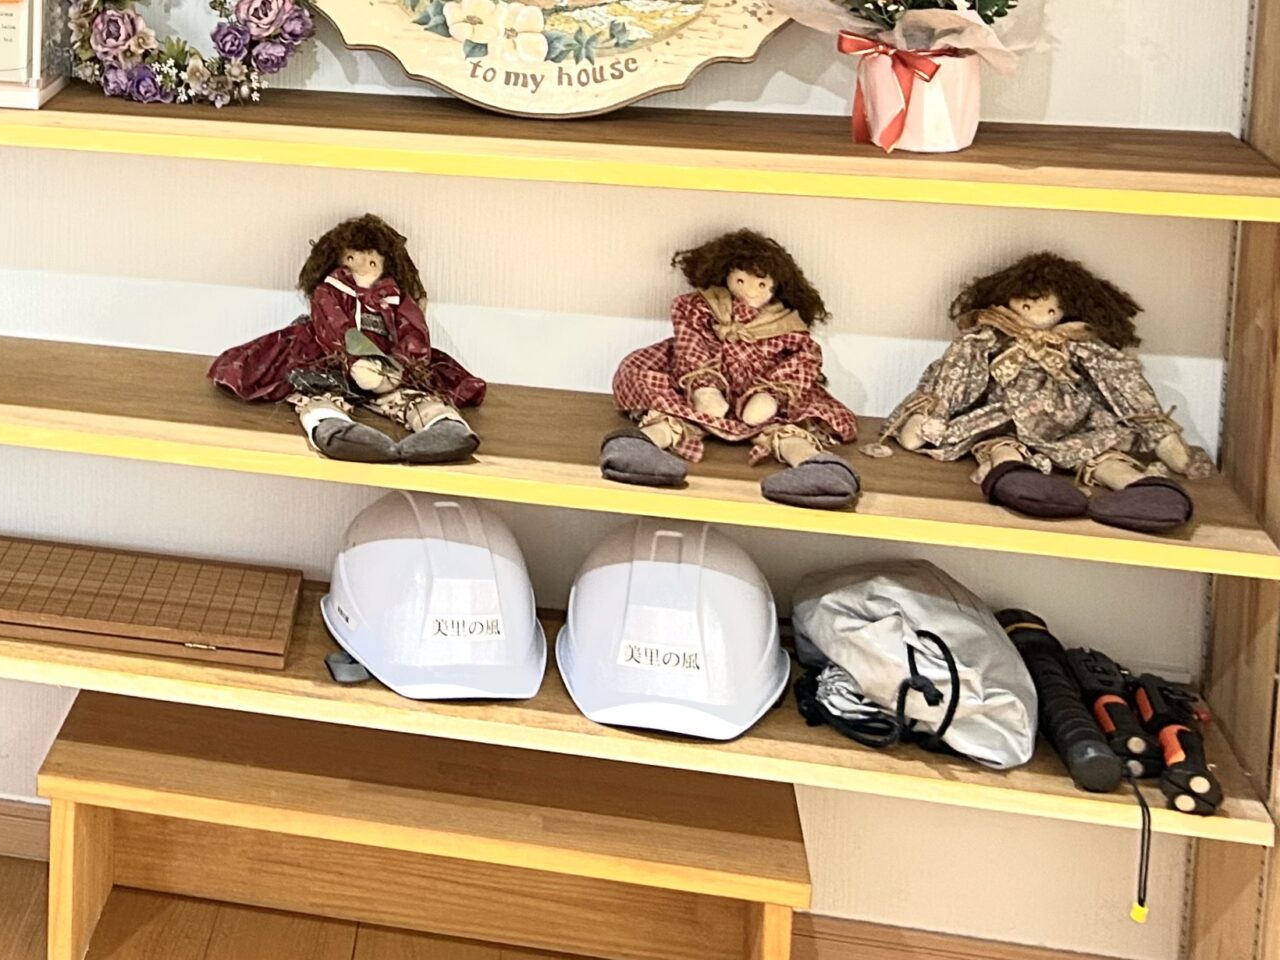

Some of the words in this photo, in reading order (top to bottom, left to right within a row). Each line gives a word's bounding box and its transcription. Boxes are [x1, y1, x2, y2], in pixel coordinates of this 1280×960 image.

[469, 59, 497, 83] to
[503, 70, 546, 94] my
[557, 56, 639, 88] house
[431, 618, 501, 638] 美里の風
[624, 644, 700, 671] 美里の風
